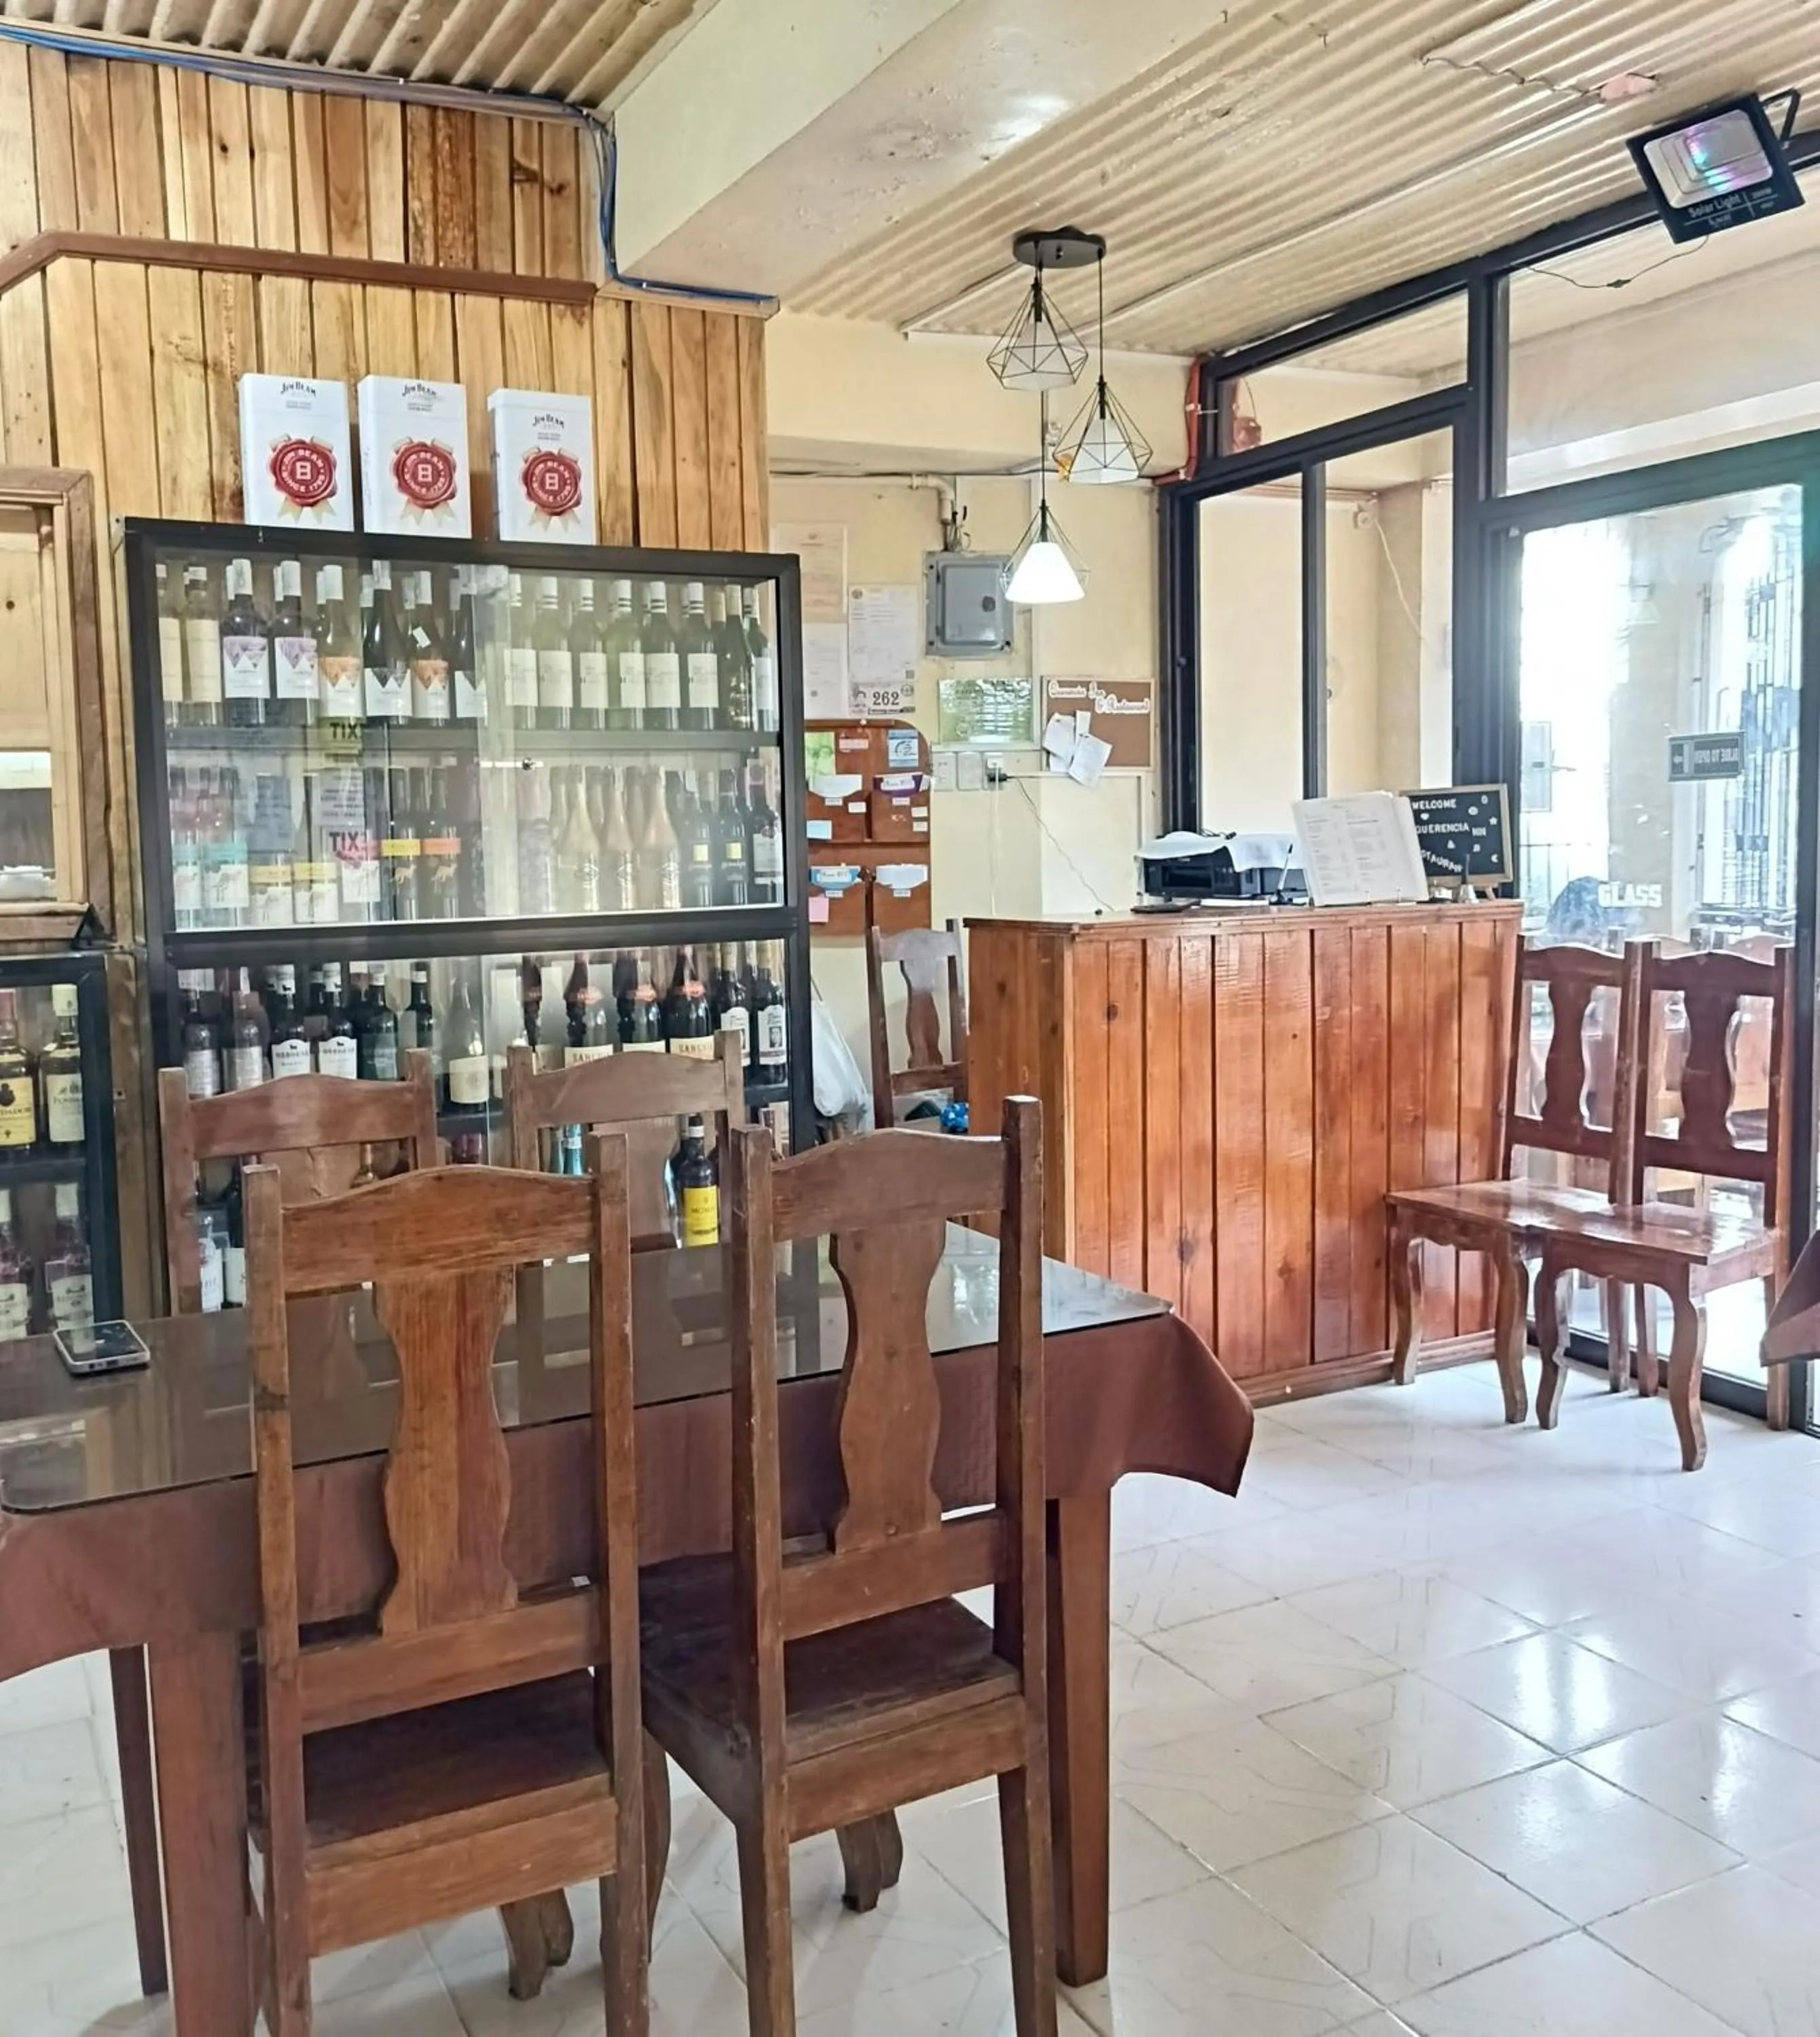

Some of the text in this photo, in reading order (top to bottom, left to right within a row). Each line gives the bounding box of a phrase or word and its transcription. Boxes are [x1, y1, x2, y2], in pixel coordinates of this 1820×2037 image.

[1688, 204, 1713, 218] Solar
[1713, 192, 1741, 210] Light
[873, 691, 899, 705] 262
[1413, 799, 1457, 809] WELCOME
[1415, 822, 1470, 834] QUERENCIA
[1421, 849, 1463, 873] STAURANT
[1598, 884, 1662, 909] GLASS
